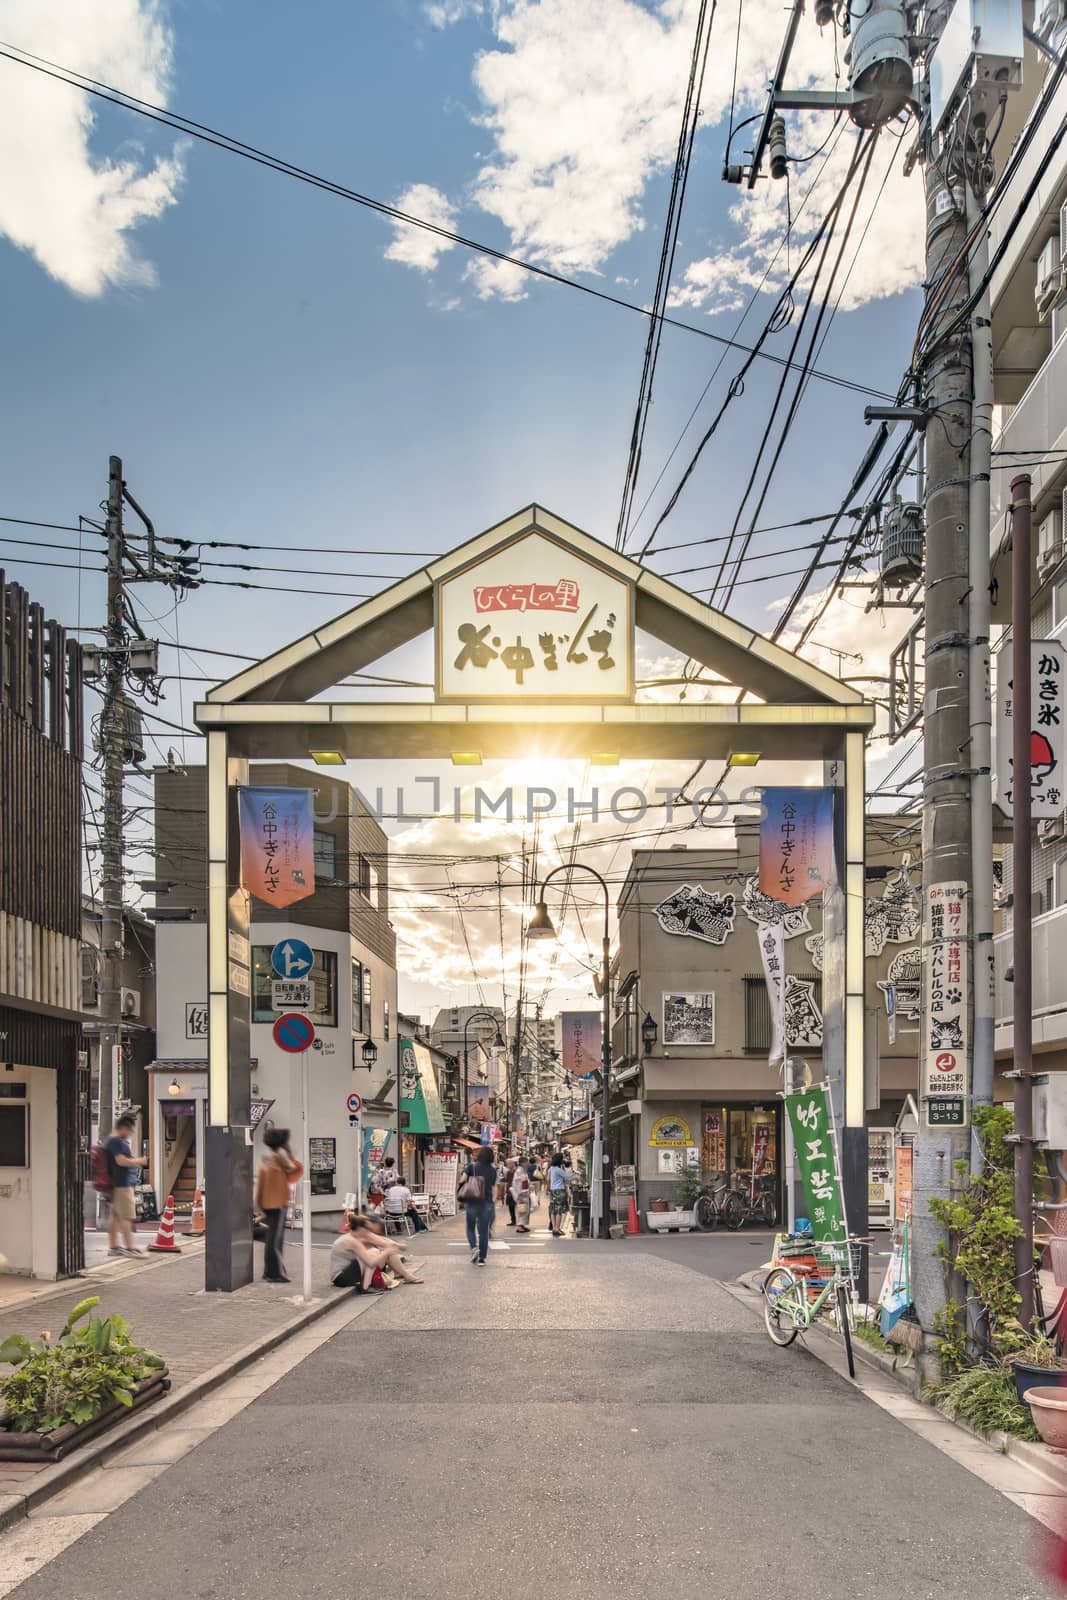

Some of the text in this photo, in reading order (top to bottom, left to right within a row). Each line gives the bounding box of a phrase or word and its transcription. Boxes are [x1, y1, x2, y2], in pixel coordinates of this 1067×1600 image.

[475, 579, 578, 611] ひぐらしの里
[1037, 654, 1061, 726] かき氷
[263, 801, 279, 894] 谷中ぎんざ
[780, 801, 796, 893] 谷中ぎんざ
[932, 1112, 959, 1121] 3-13
